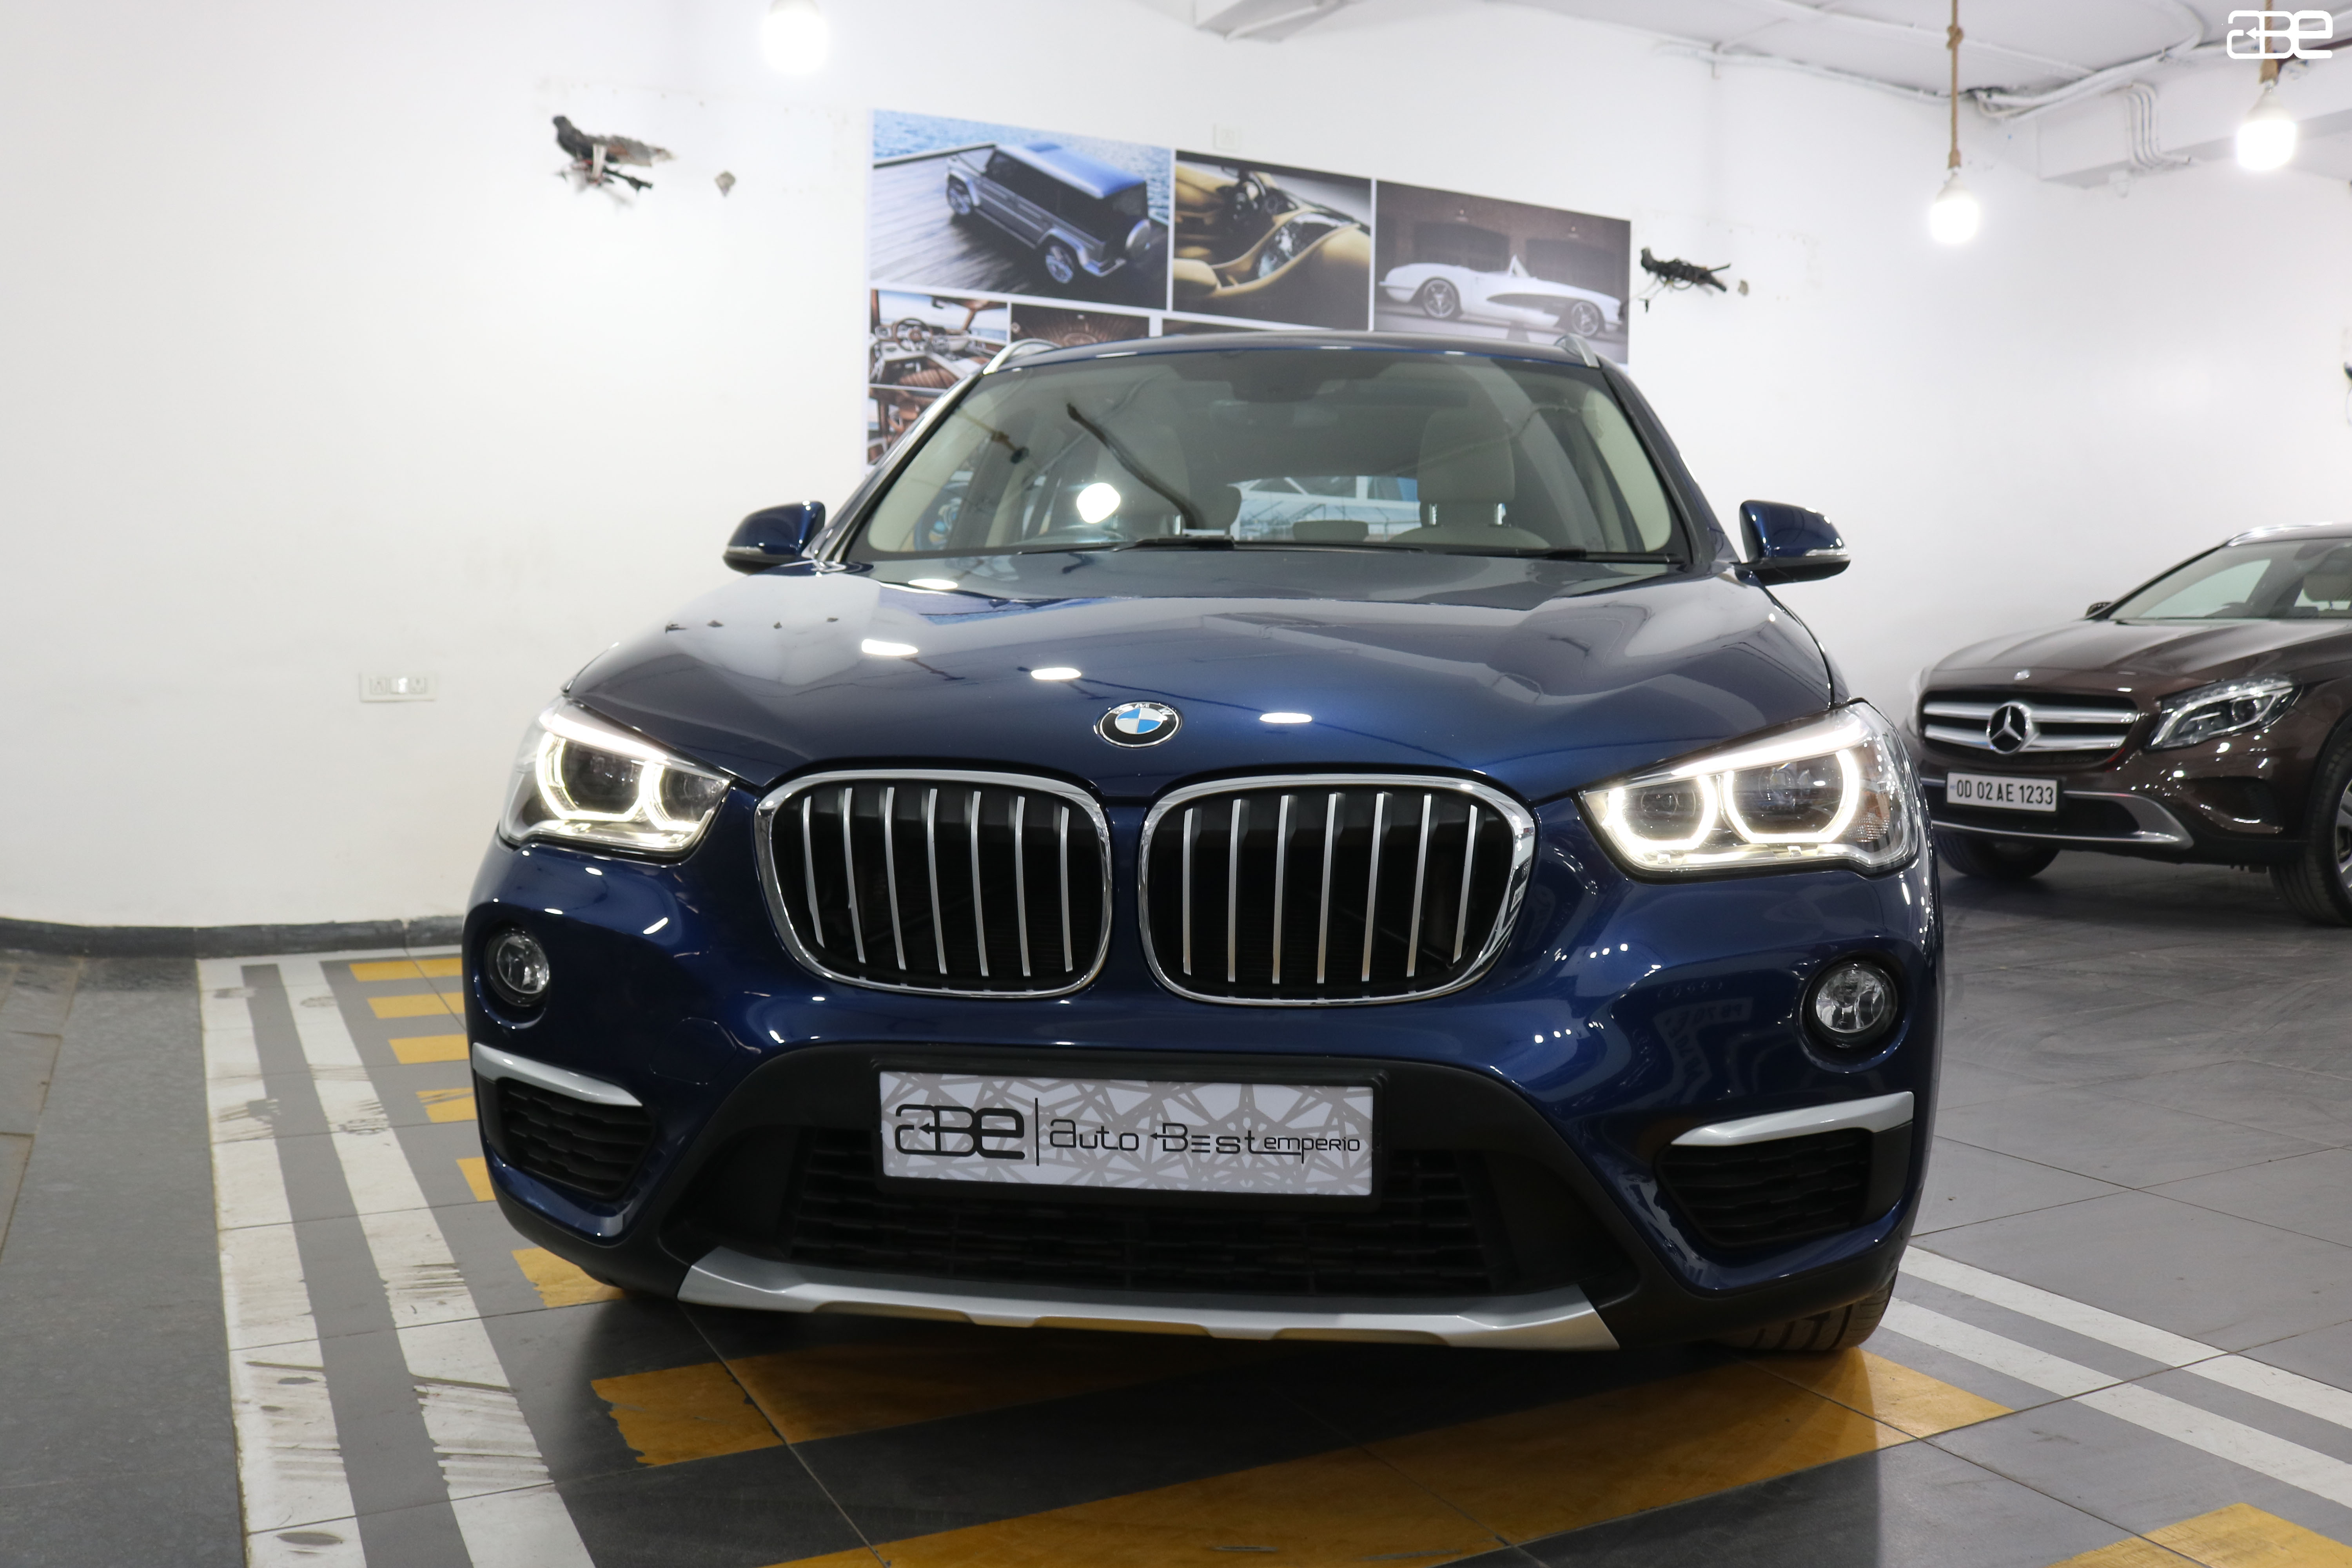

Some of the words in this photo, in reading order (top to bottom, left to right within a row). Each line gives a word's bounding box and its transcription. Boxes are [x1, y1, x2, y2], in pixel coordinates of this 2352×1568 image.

[1957, 780, 1972, 798] OD
[1977, 781, 1993, 800] 02
[1996, 783, 2014, 802] AE
[2019, 785, 2053, 805] 1233
